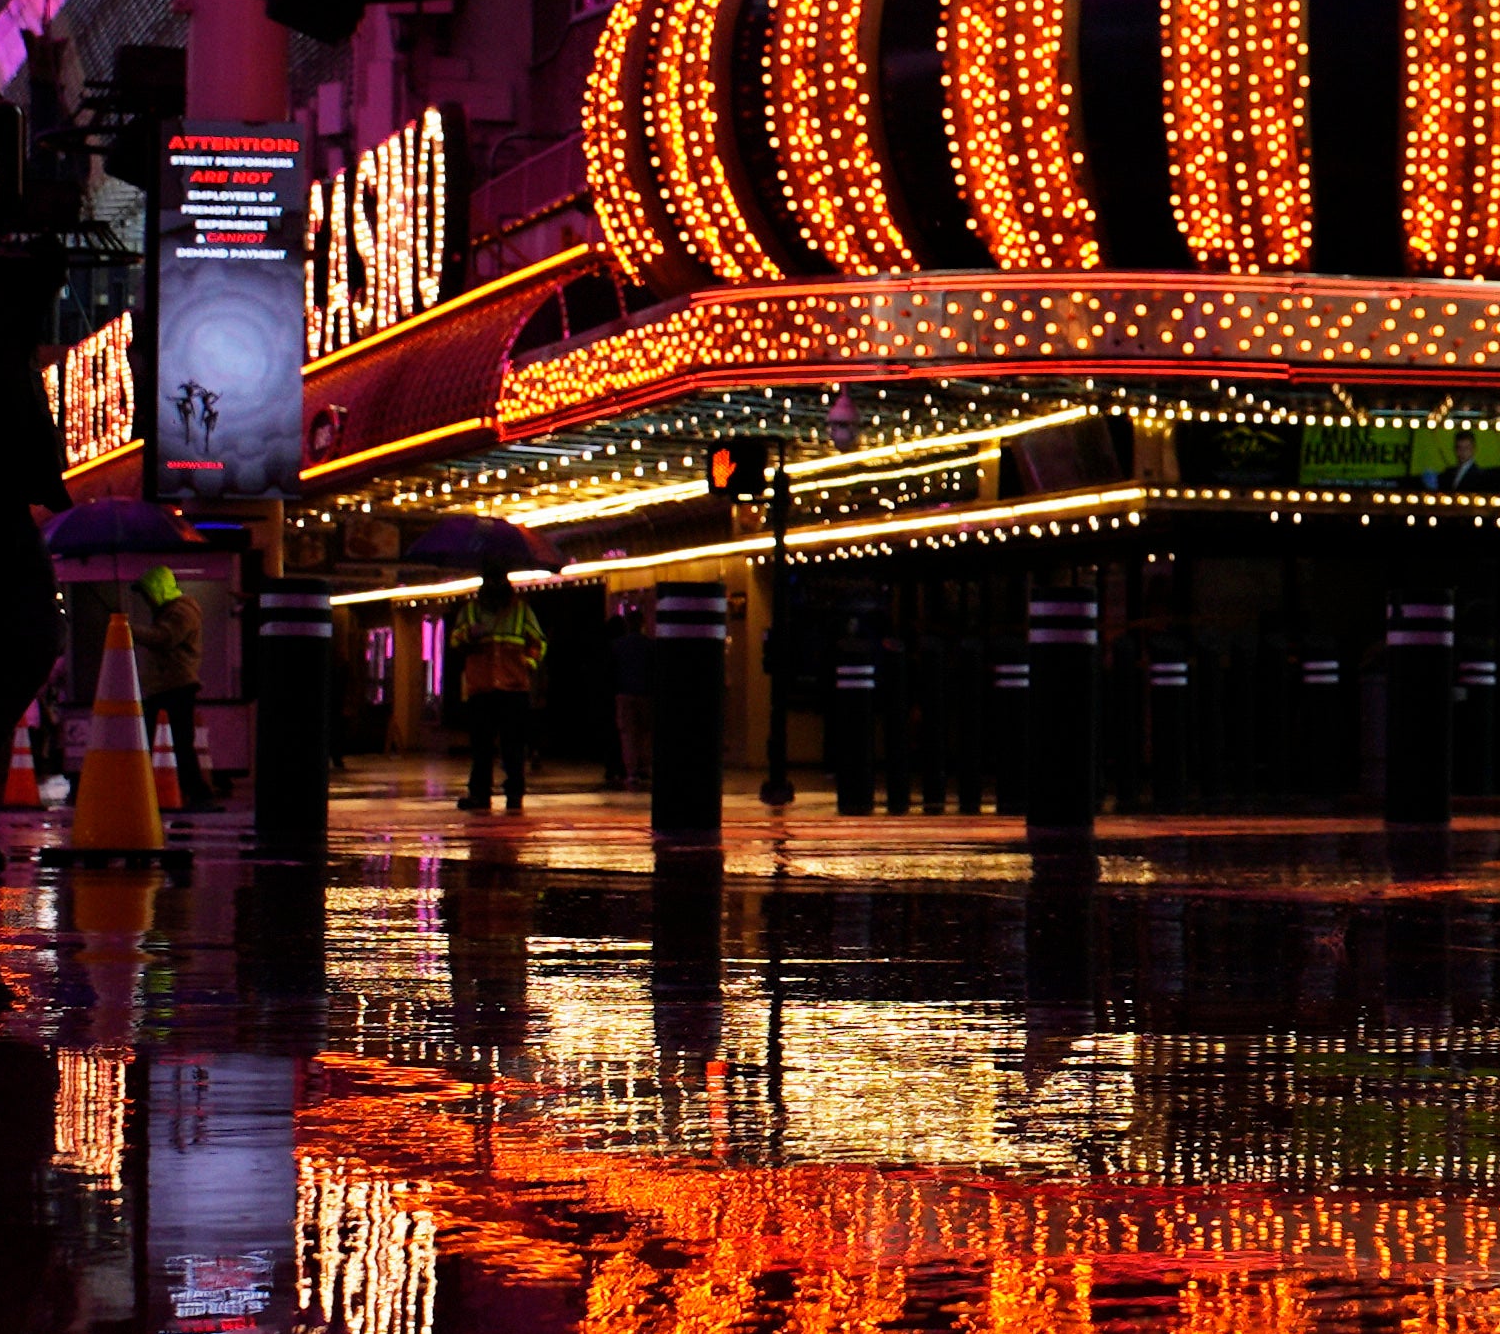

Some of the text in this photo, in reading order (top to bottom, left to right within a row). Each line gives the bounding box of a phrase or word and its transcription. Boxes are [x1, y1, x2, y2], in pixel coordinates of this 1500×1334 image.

[189, 170, 274, 184] ARE NOT
[205, 232, 267, 243] CANNOT
[1303, 442, 1412, 465] HAMMER
